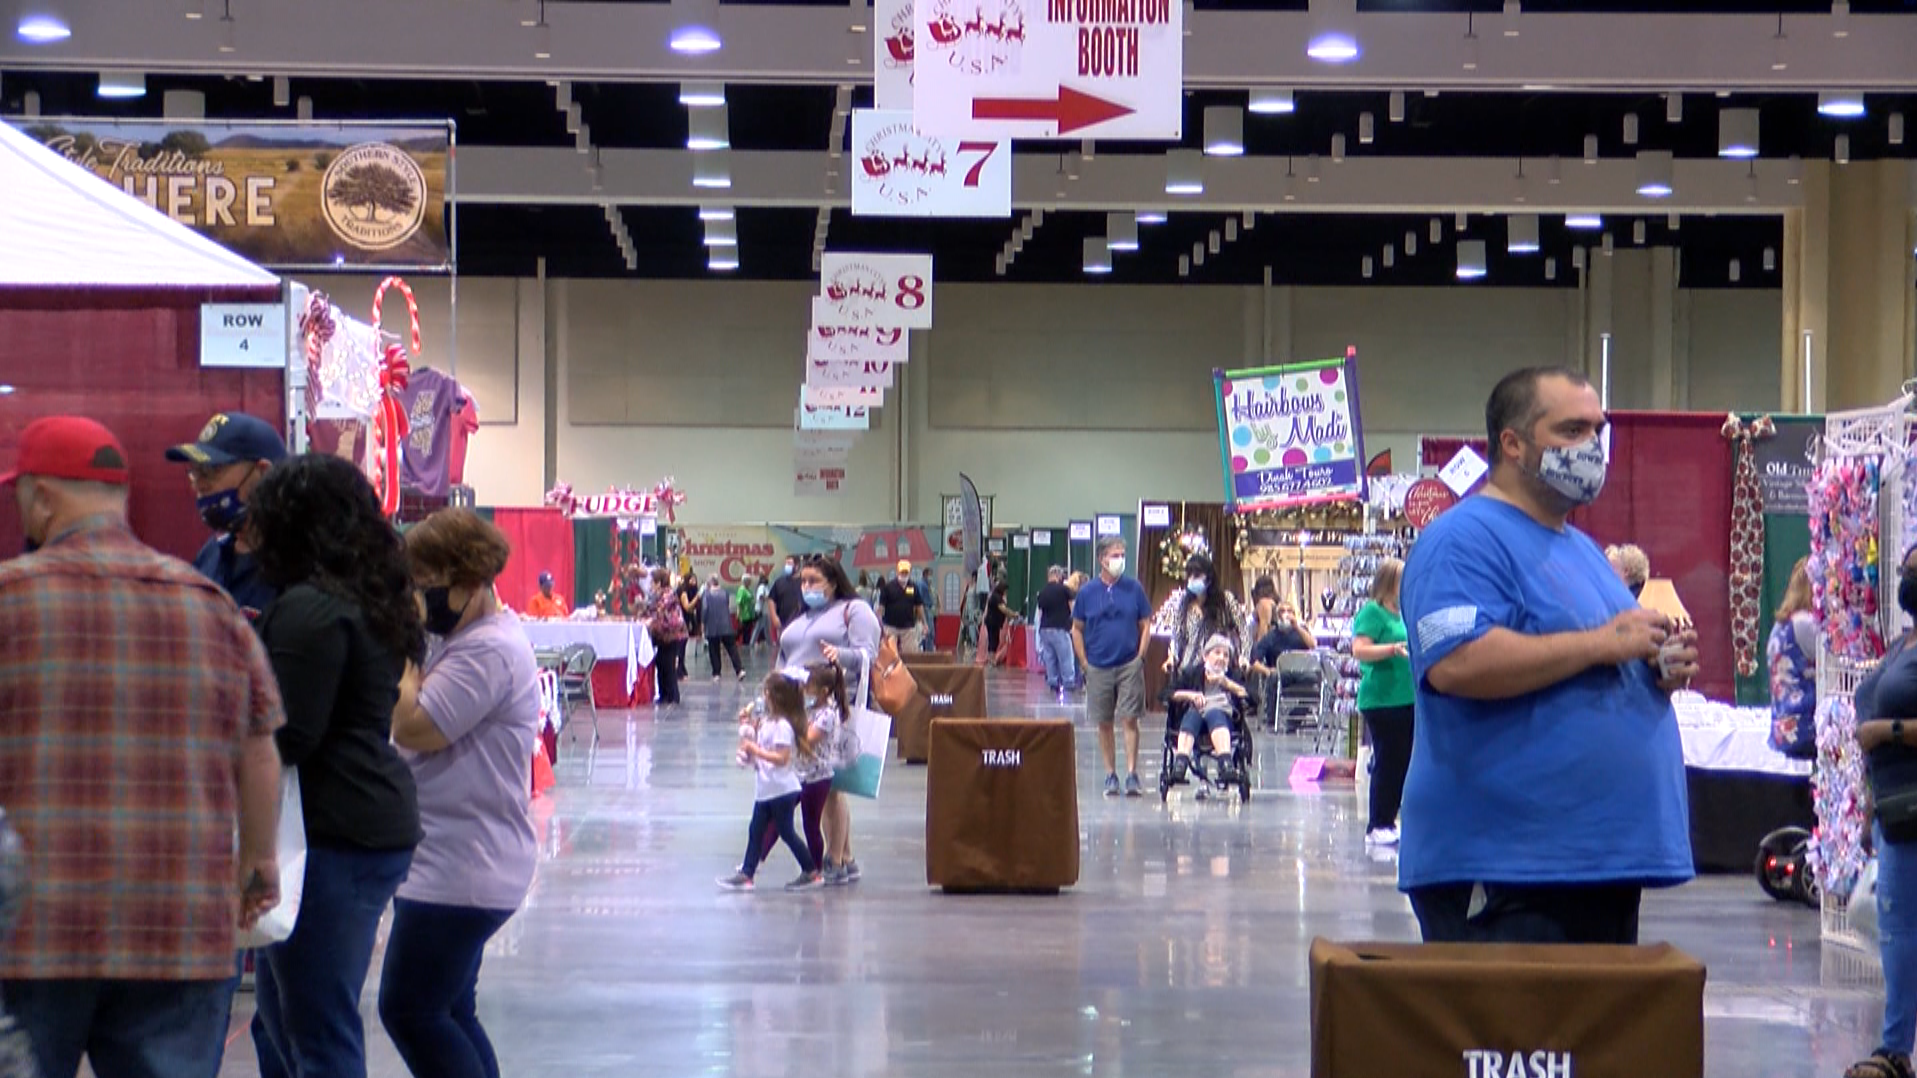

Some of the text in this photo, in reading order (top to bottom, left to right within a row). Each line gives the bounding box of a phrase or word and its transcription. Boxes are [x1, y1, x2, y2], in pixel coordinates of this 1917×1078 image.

[1078, 28, 1139, 76] BOOTH
[100, 139, 225, 179] Traditions
[956, 140, 999, 188] 7
[122, 175, 276, 227] HERE
[342, 213, 404, 238] TRADITIONS
[894, 274, 925, 310] 8
[223, 314, 263, 327] ROW
[239, 338, 249, 352] 4
[876, 326, 902, 346] 9
[1232, 386, 1325, 422] Hairbows
[1279, 410, 1348, 449] Madi
[1766, 462, 1787, 475] Old
[569, 494, 658, 514] FUDGE
[1326, 531, 1344, 543] Wi
[720, 555, 775, 585] City
[930, 694, 953, 705] TRASH
[981, 748, 1021, 766] TRASH
[1462, 1049, 1571, 1078] TRASH
